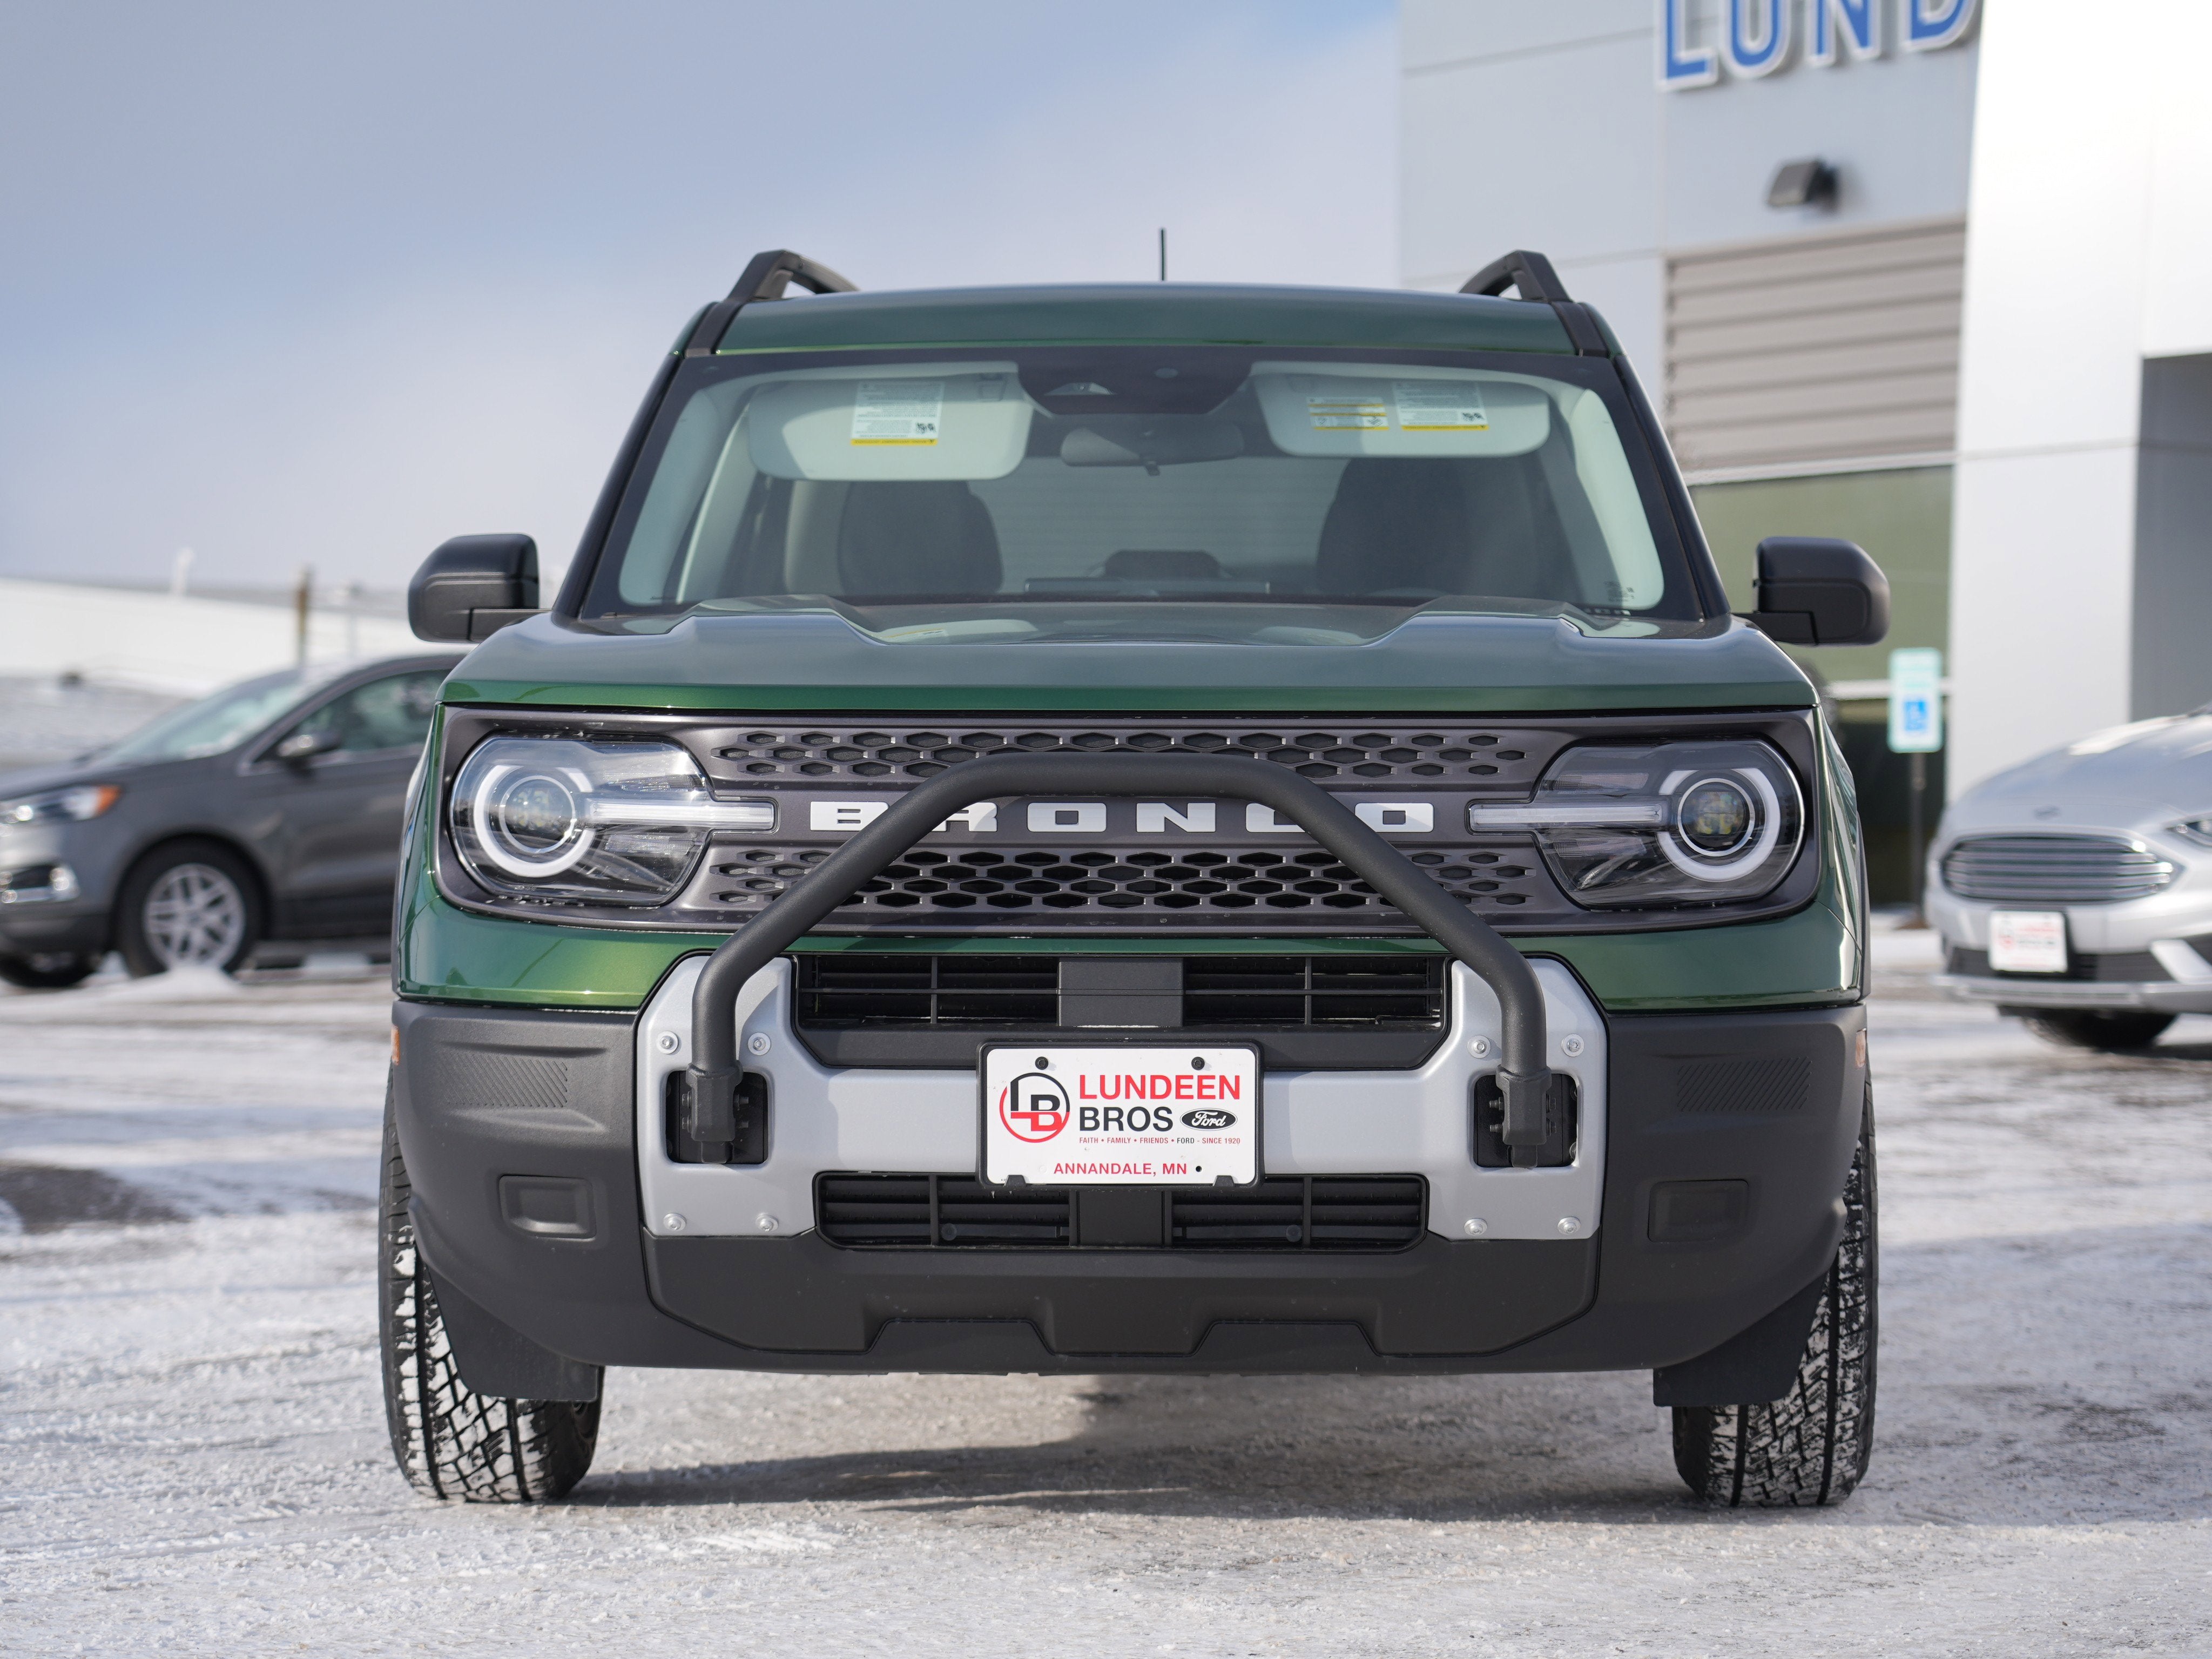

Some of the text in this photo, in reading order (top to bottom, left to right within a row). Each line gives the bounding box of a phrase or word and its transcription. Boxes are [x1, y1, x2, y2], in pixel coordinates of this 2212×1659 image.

[1080, 1075, 1240, 1100] LUNDEEN
[1080, 1106, 1174, 1132] BROS
[1054, 1163, 1187, 1177] ANNANDALE, MN
